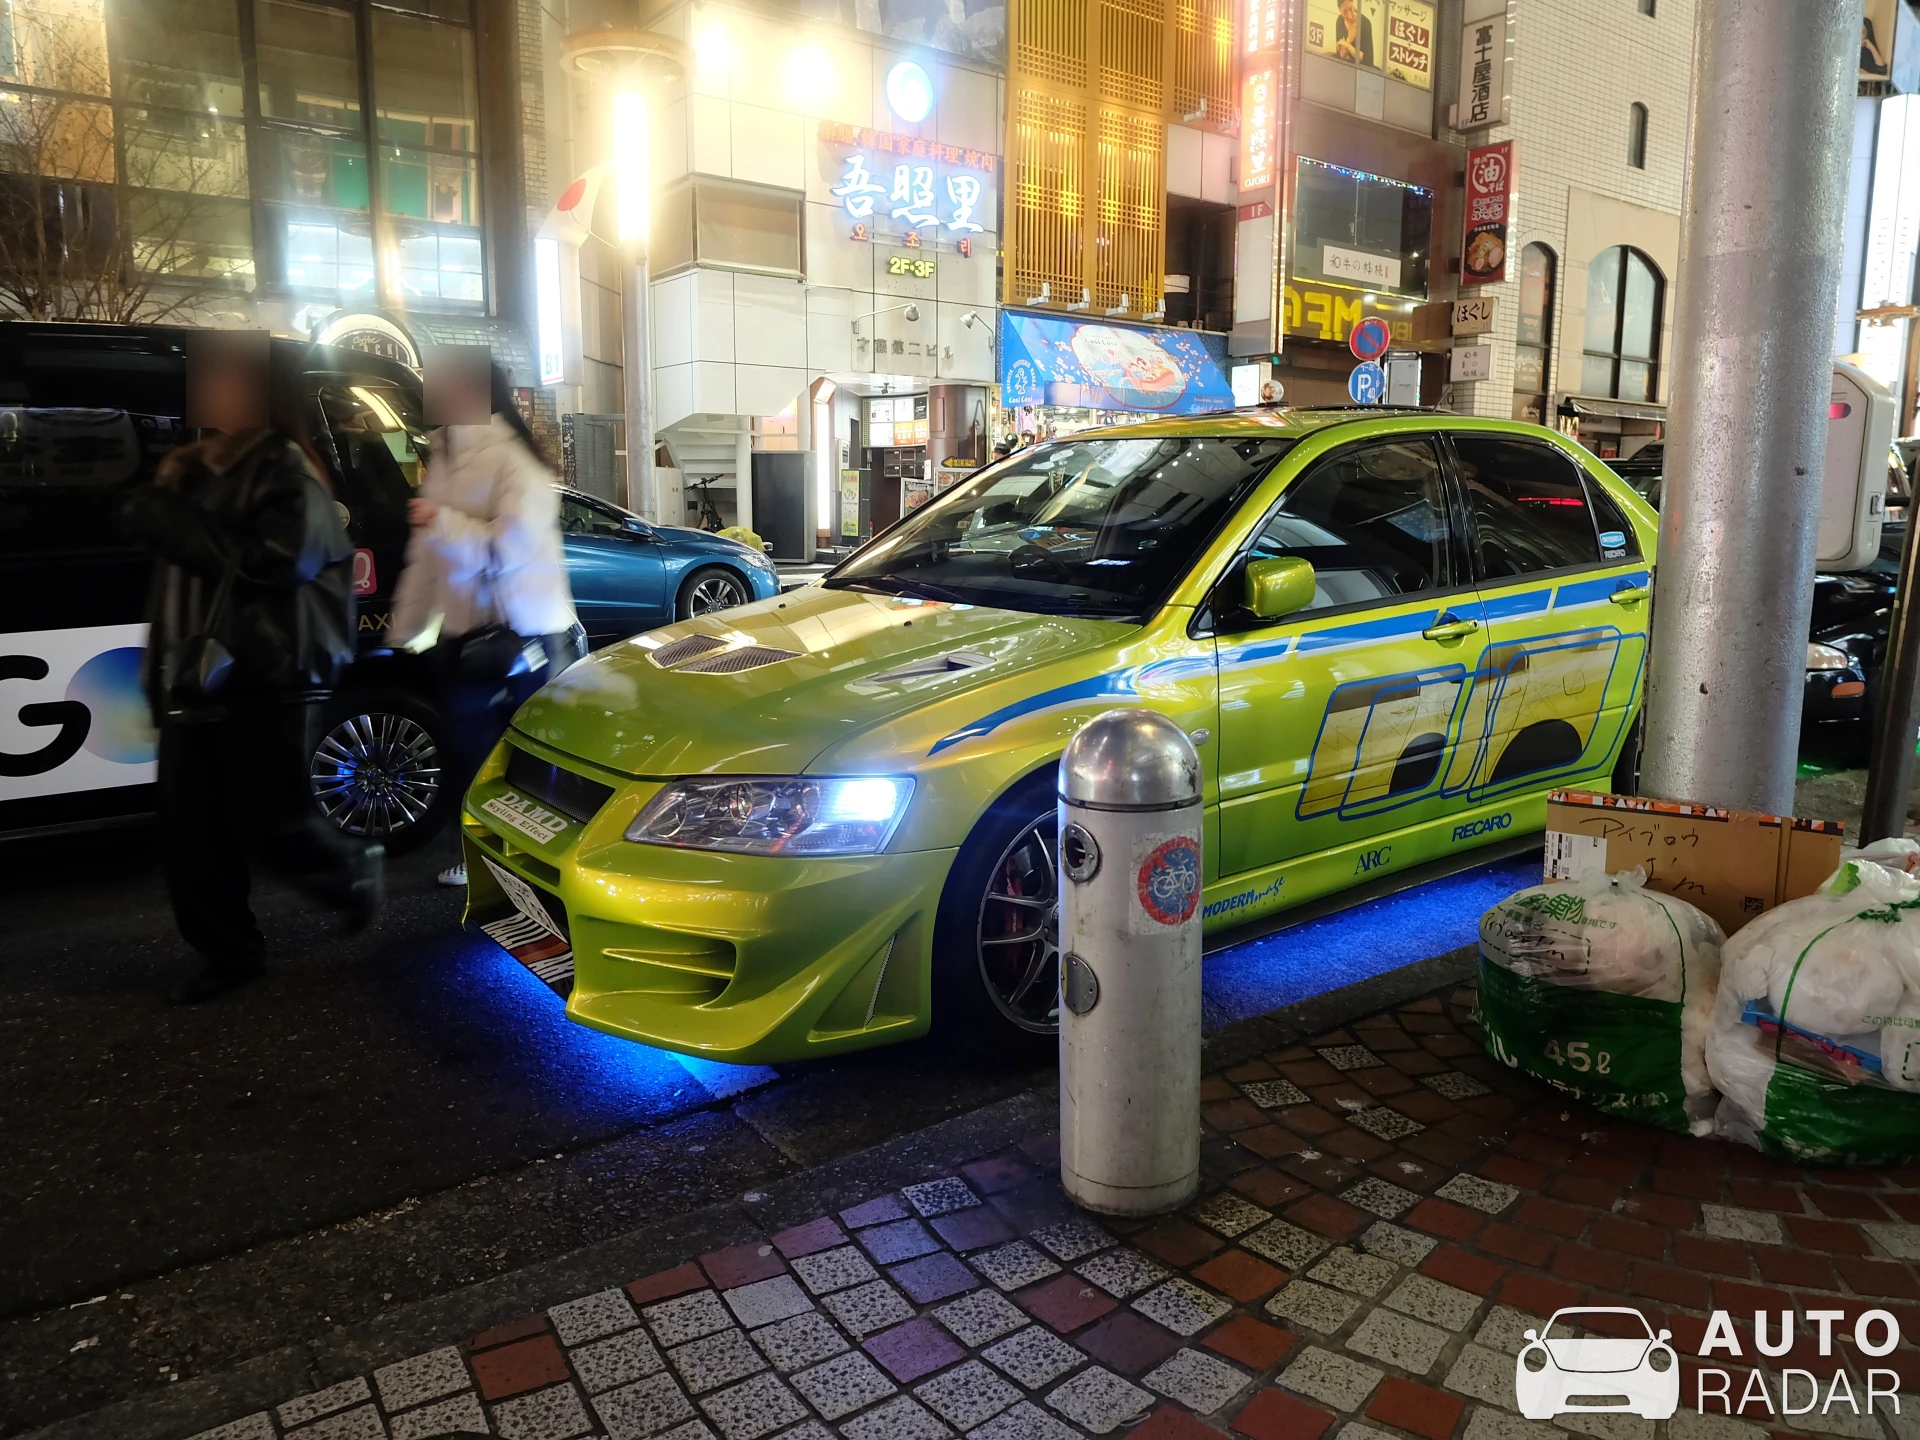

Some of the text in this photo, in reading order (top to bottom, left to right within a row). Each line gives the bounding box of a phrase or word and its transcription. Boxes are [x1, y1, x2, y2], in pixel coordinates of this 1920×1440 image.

[1389, 1, 1428, 23] マッサージ
[1309, 25, 1324, 45] 3F
[1394, 19, 1427, 45] ほぐし
[1390, 45, 1429, 71] ストレッチ
[1470, 25, 1494, 123] 富士屋酒店
[964, 148, 994, 172] 焼肉
[830, 153, 984, 234] 吾照里
[1244, 173, 1271, 189] OJORI
[1250, 203, 1264, 217] 1F
[1456, 301, 1491, 323] ほぐし
[352, 335, 382, 346] Coffee
[1357, 374, 1372, 402] P
[487, 801, 549, 841] Styling Effect
[495, 790, 569, 833] DAMD
[1451, 812, 1513, 843] RECARO
[1578, 816, 1700, 848] アイブロウ
[1353, 845, 1393, 876] ARC
